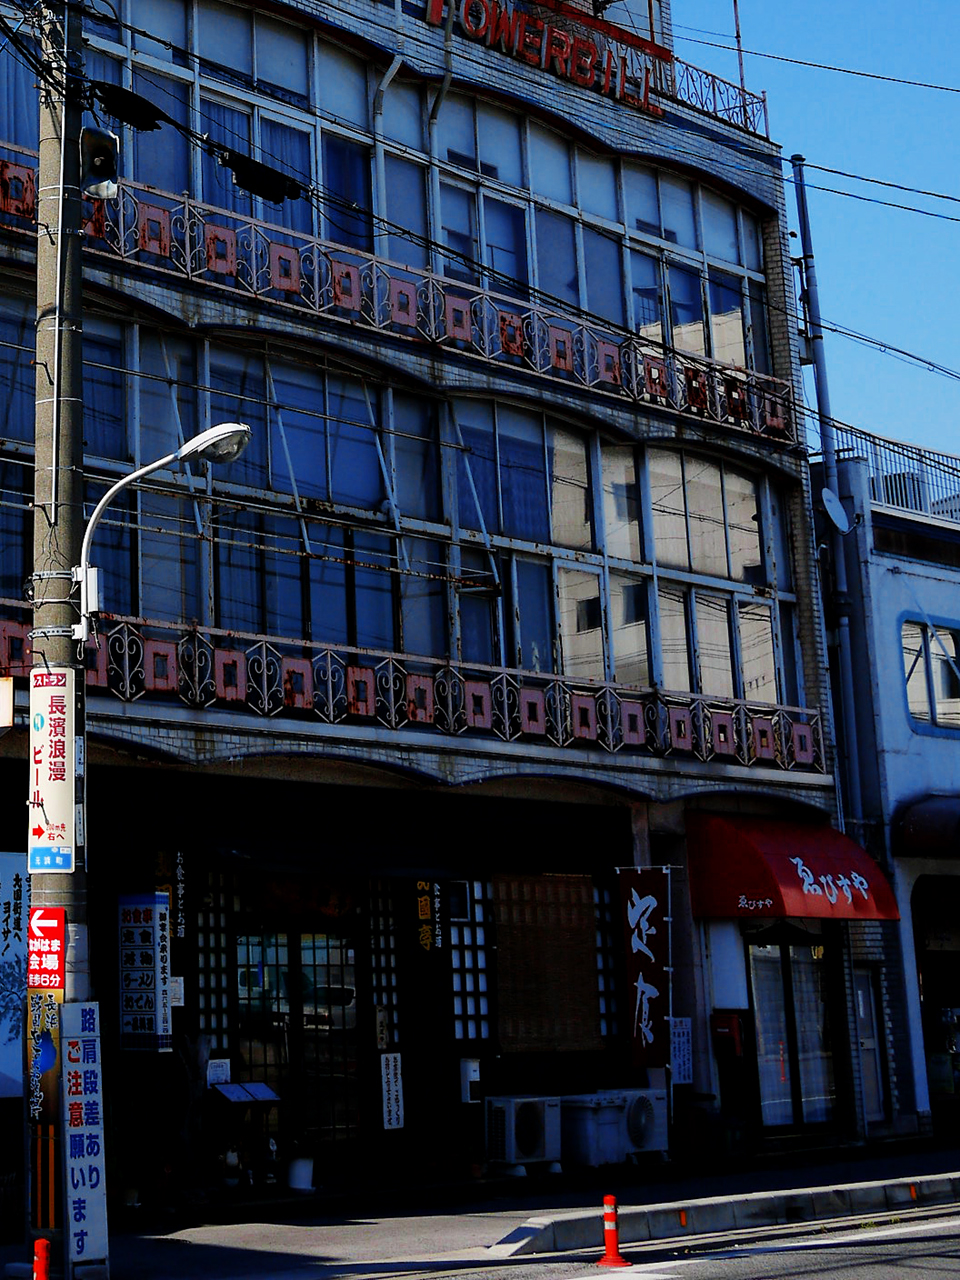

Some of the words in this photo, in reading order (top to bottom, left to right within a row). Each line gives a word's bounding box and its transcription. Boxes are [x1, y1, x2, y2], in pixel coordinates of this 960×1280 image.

[48, 695, 67, 782] 長濱浪漫
[32, 744, 45, 809] ビール
[47, 832, 66, 841] 右へ
[788, 856, 869, 905] ゑびすや
[737, 894, 774, 910] ゑびすや
[121, 907, 153, 924] お食事
[123, 973, 154, 988] ラーメン
[124, 994, 154, 1010] おでん
[81, 1007, 101, 1190] 路肩段差あり
